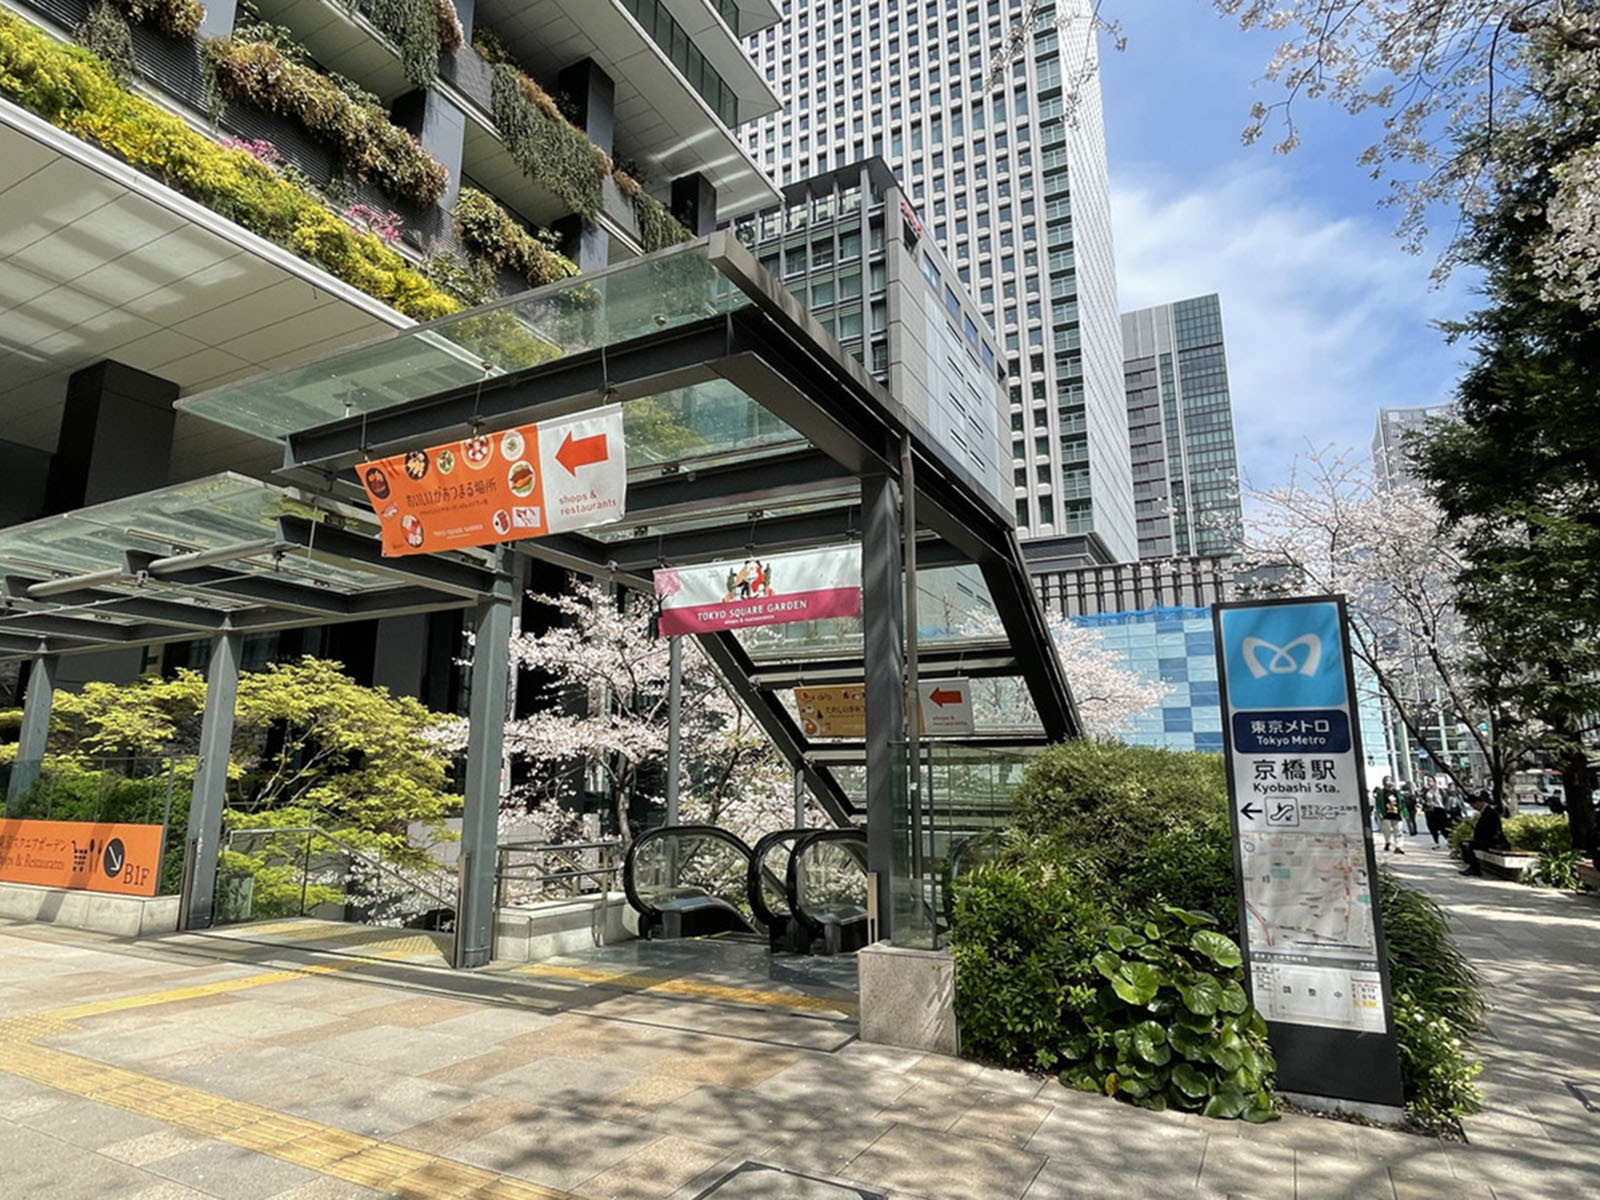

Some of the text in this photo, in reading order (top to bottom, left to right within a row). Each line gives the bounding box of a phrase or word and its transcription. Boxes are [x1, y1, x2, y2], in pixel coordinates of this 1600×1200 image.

[559, 489, 597, 505] shops &
[560, 498, 617, 515] restaurants
[697, 600, 808, 621] TOKYO SQUARE GARDEN
[1250, 720, 1330, 734] 東京メトロ
[1257, 735, 1327, 747] Tokyo Metro
[1253, 759, 1336, 780] 京橋駅
[1253, 782, 1341, 794] Kyobashi Sta.
[123, 863, 150, 886] B1F
